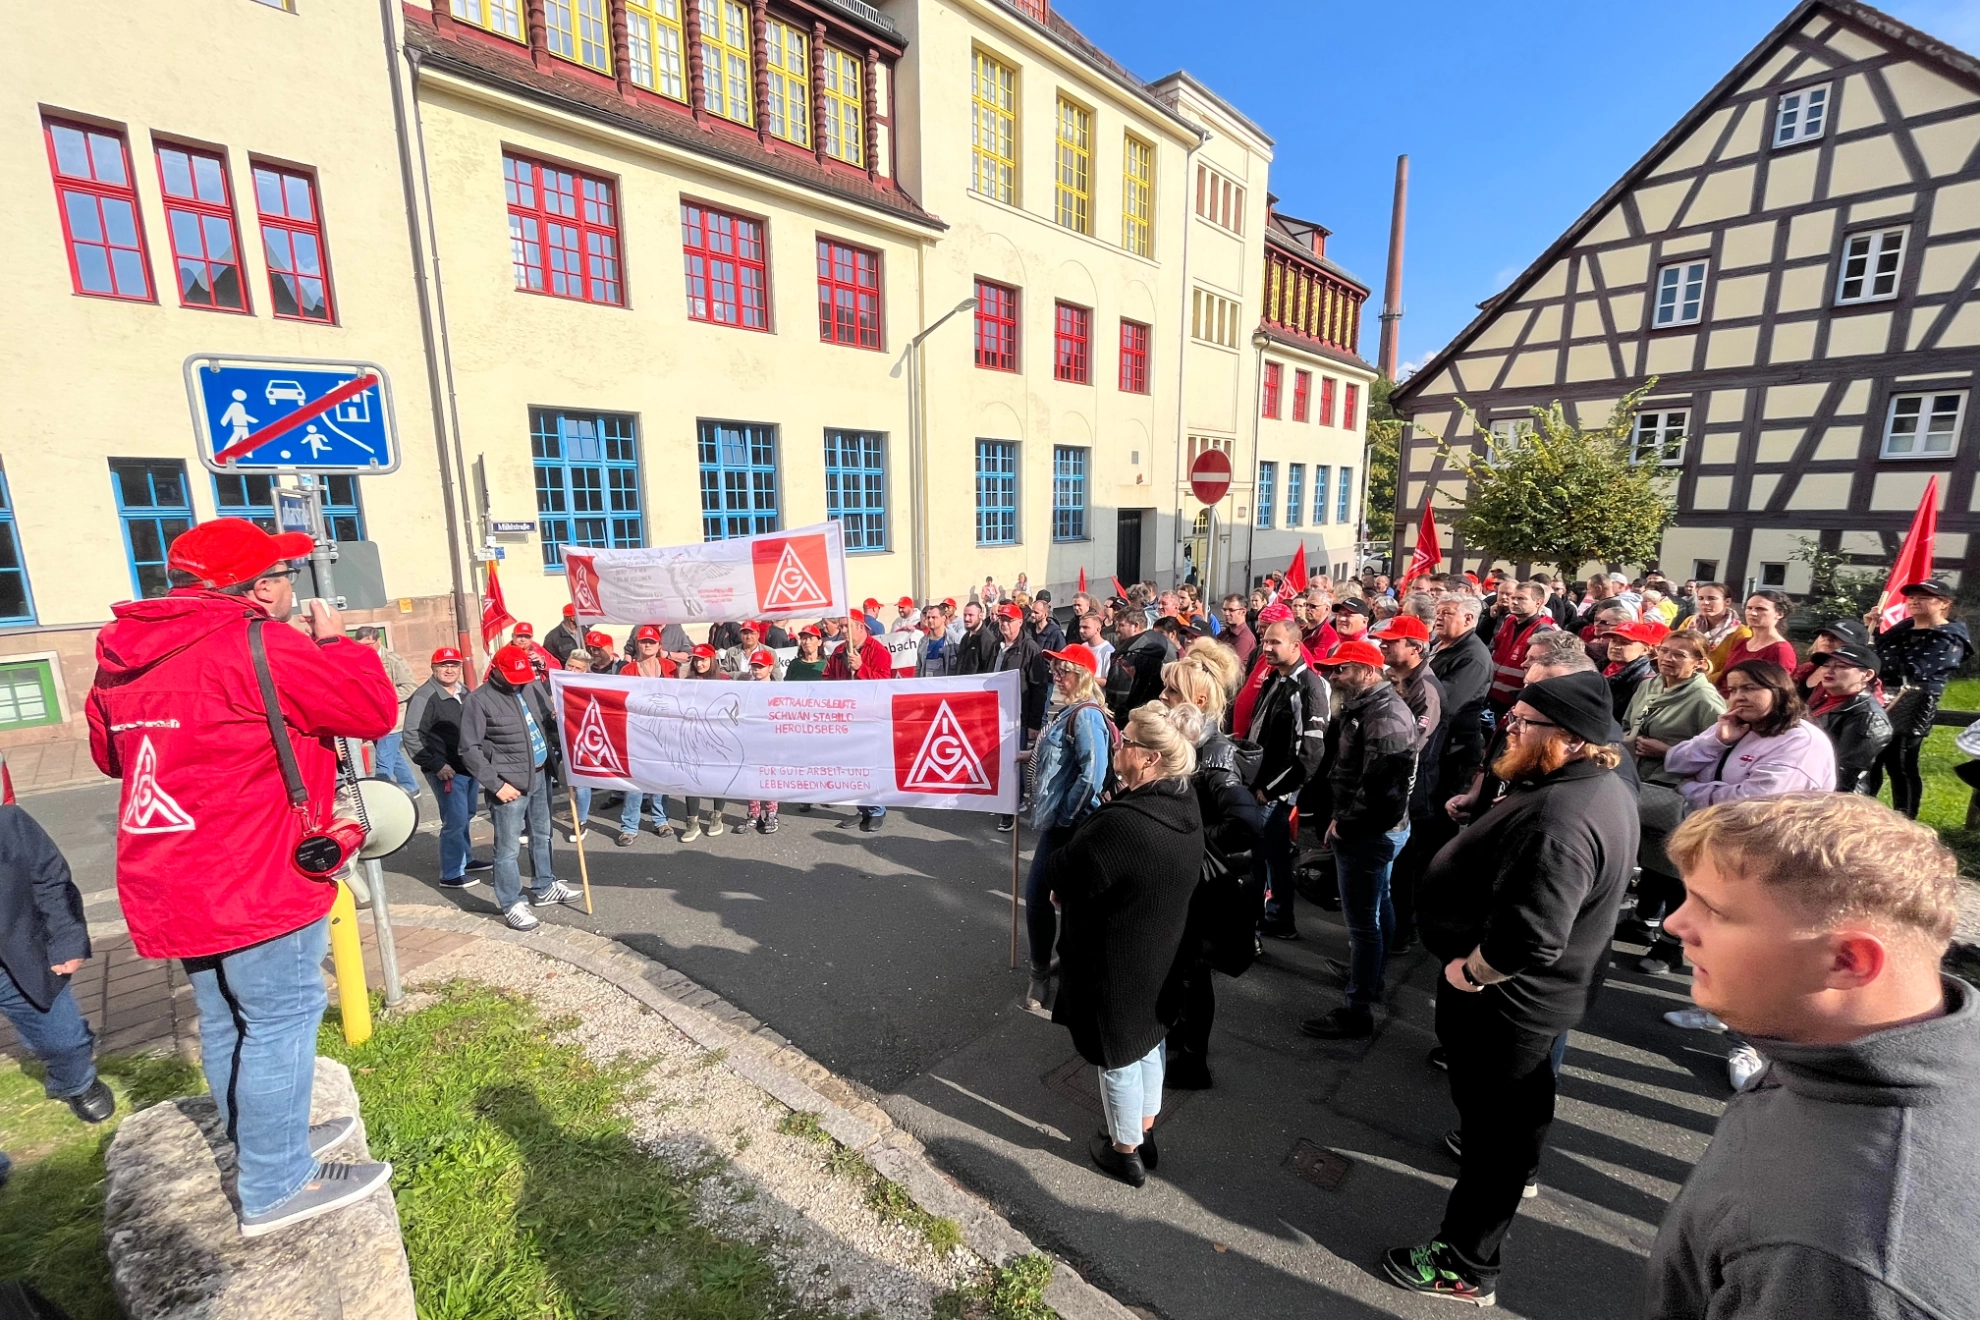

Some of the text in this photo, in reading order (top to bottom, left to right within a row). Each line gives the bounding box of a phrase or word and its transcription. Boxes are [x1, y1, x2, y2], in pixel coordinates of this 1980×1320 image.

[884, 638, 917, 653] bach
[767, 697, 857, 709] VERTRAUENSLEUTE
[768, 711, 854, 722] SCHWAN STABILO
[775, 724, 849, 735] HEROLDSBERG
[780, 766, 804, 776] GUTE
[807, 766, 846, 776] ARBEIT-
[848, 767, 870, 777] UND
[759, 780, 871, 791] LEBENSBEDINGUNGEN
